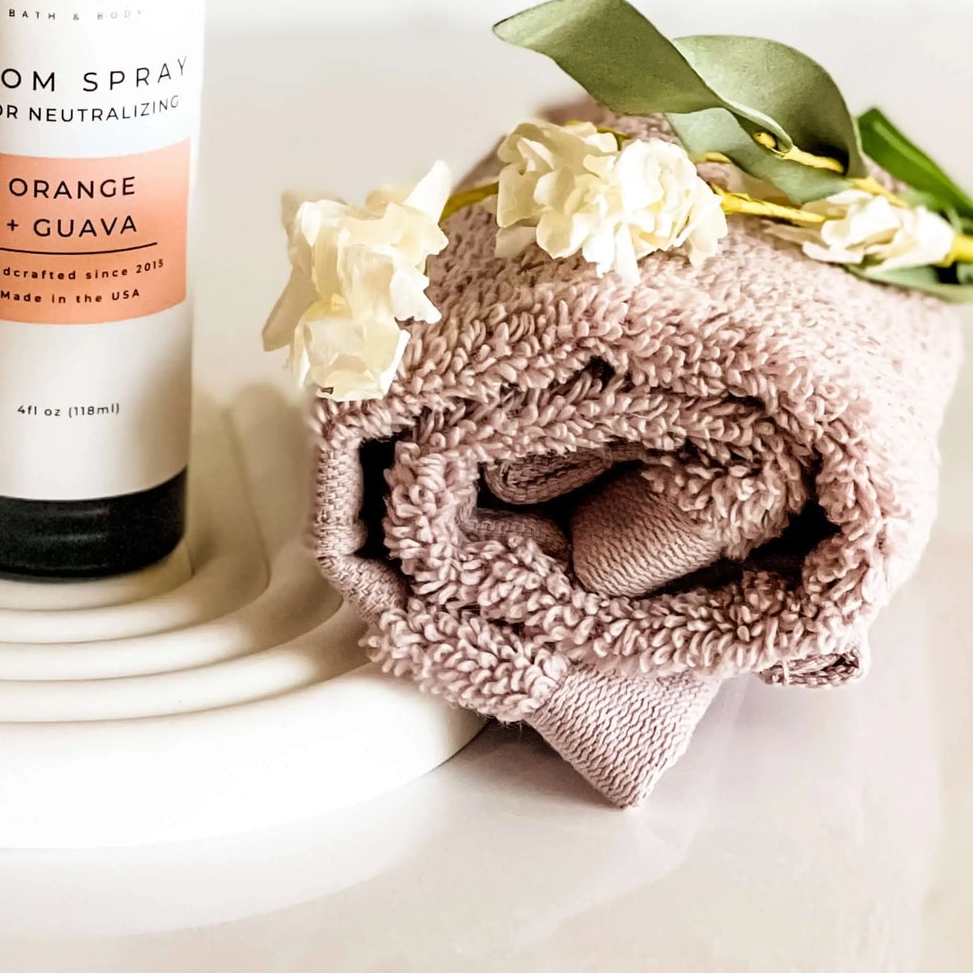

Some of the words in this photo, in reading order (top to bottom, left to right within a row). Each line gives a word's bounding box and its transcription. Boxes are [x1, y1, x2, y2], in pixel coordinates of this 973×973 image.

[8, 8, 56, 20] BATH
[72, 13, 80, 21] &
[82, 56, 188, 93] SPRAY
[28, 95, 180, 123] NEUTRALIZING
[8, 175, 136, 200] ORANGE
[6, 218, 20, 232] +
[33, 214, 138, 238] GUAVA
[85, 267, 129, 280] since
[135, 258, 165, 275] 2015
[0, 289, 43, 304] Made
[51, 292, 67, 304] in
[75, 292, 103, 304] the
[111, 288, 141, 302] USA
[16, 403, 38, 417] 4fl
[43, 408, 61, 418] oz
[68, 402, 121, 419] (118ml)
